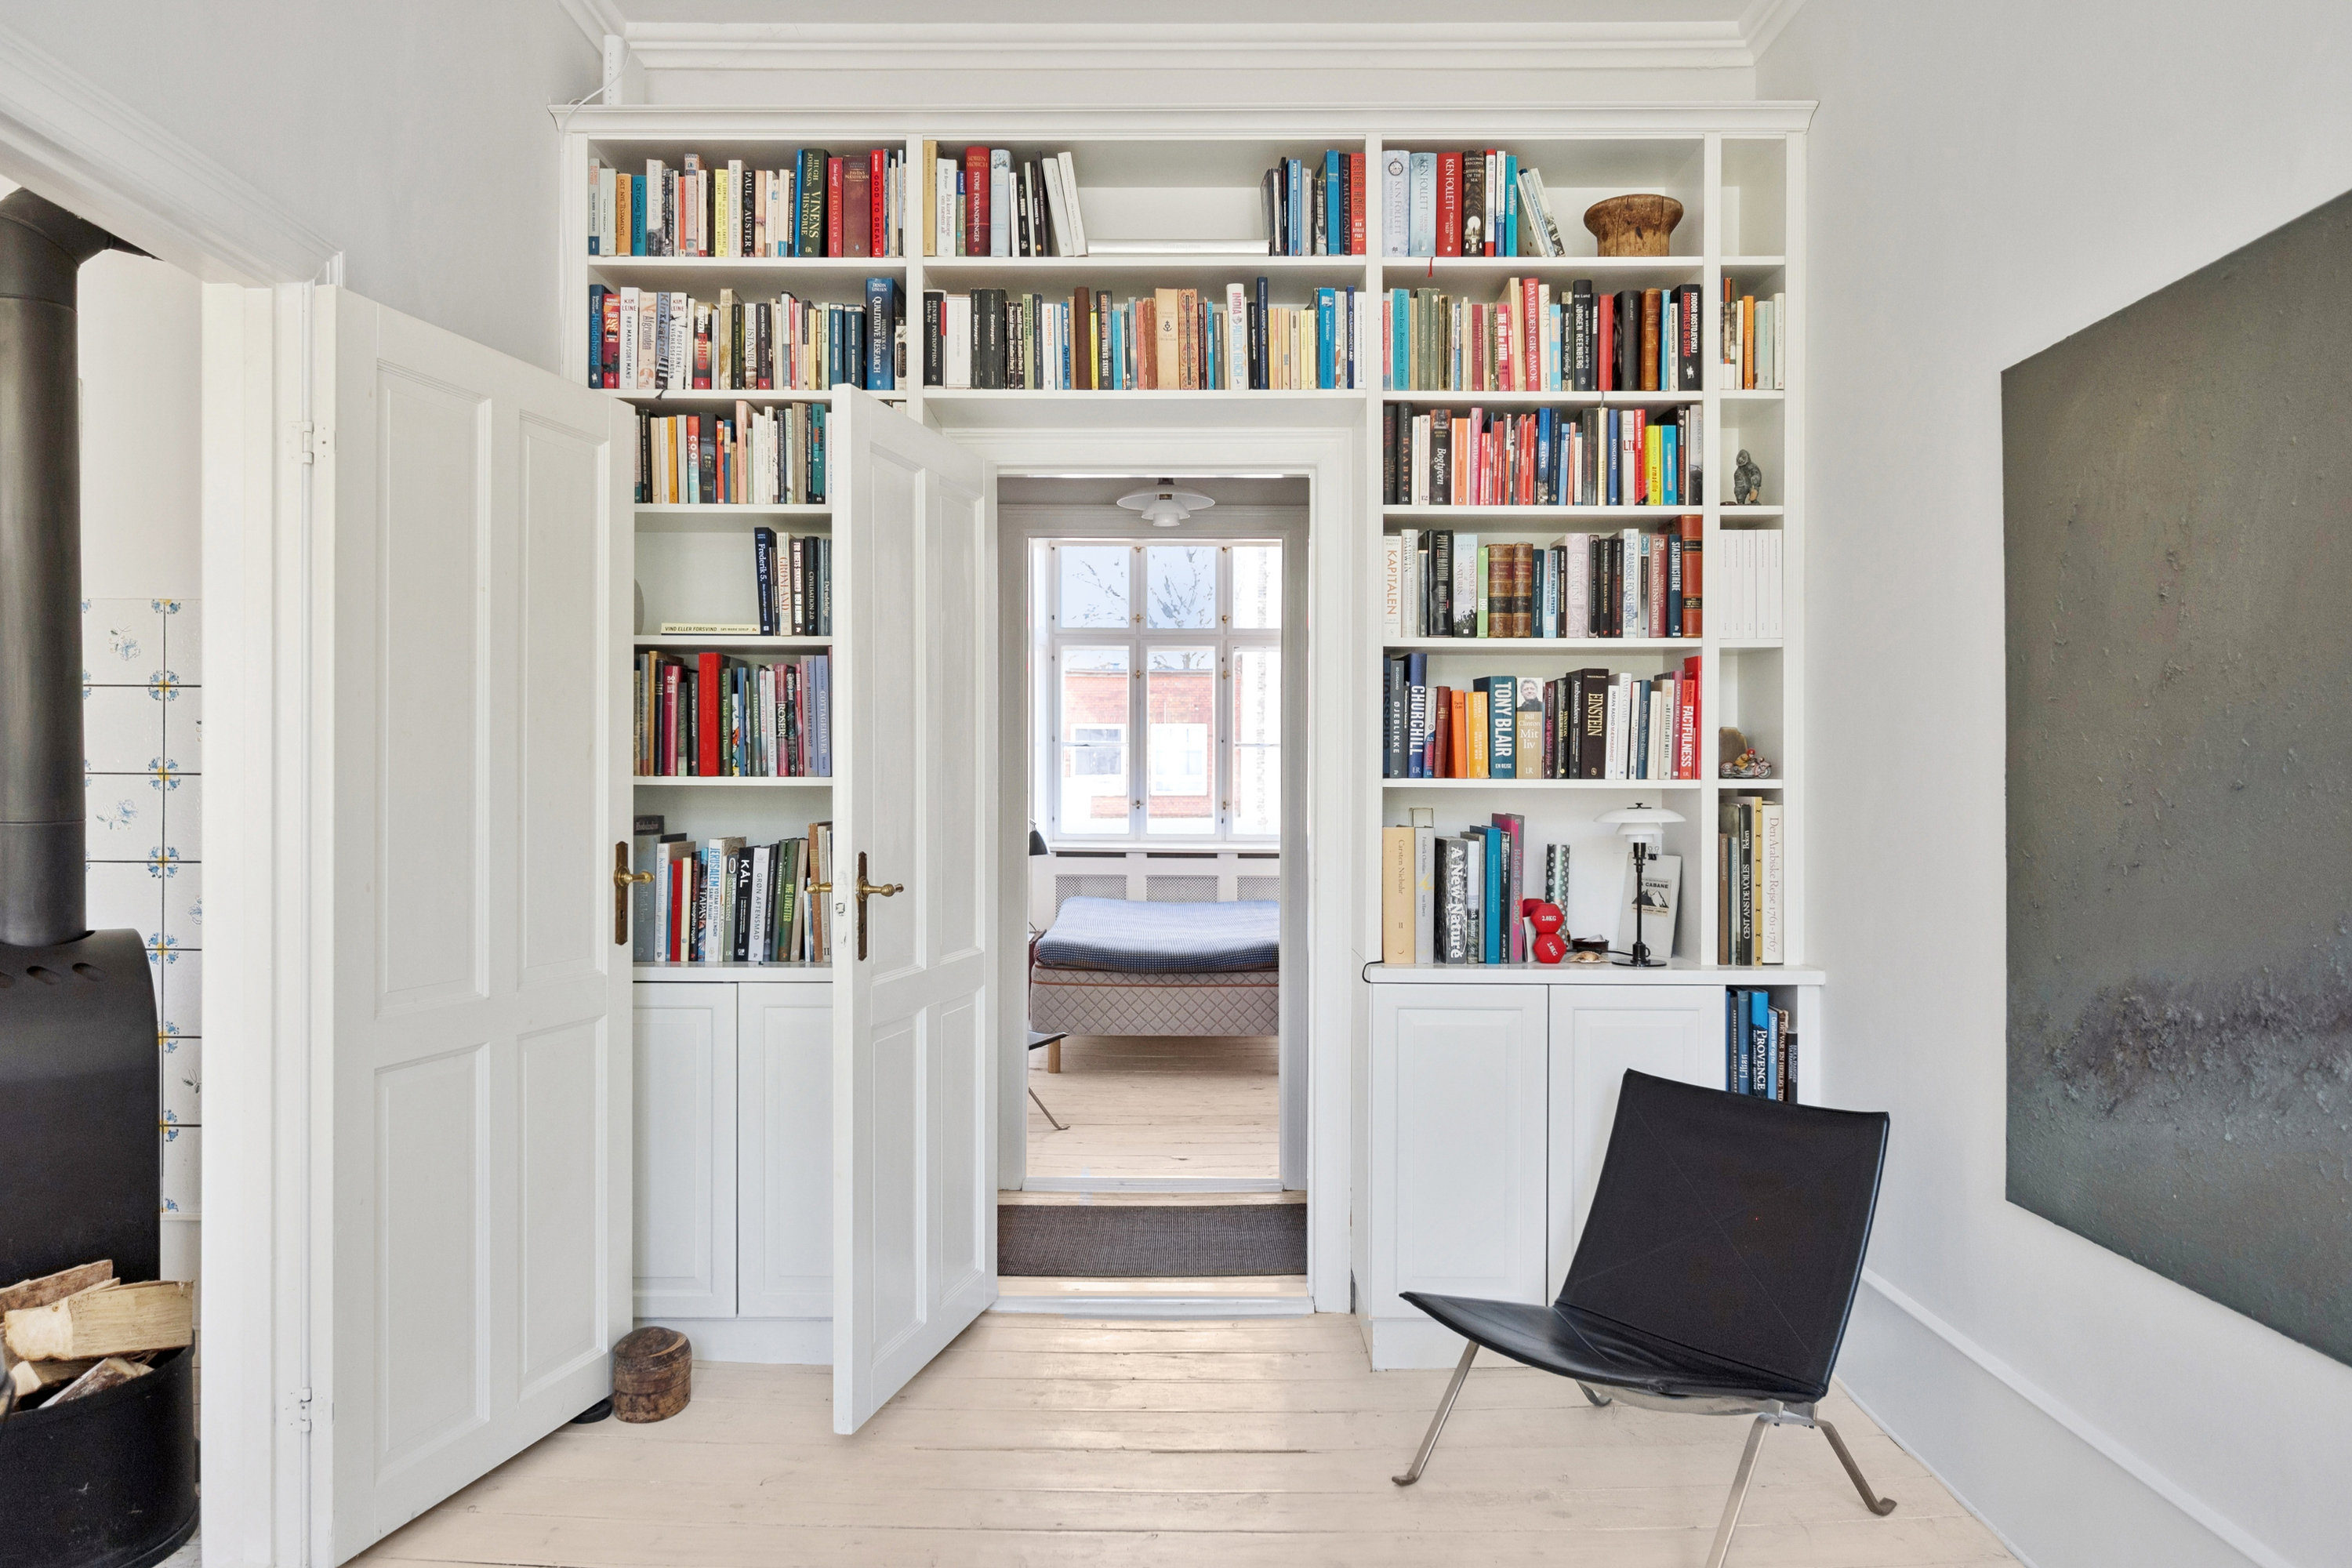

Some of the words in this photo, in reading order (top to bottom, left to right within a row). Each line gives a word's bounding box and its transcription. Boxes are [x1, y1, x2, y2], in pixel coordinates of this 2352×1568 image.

[1343, 169, 1349, 180] DE
[1446, 159, 1454, 176] KEN
[874, 203, 880, 212] TO
[1446, 178, 1454, 211] FOLLETT
[801, 193, 810, 235] HISTORIE
[809, 191, 821, 238] VINENS
[1528, 283, 1535, 295] DA
[873, 296, 882, 336] QUALITATIVE
[1232, 293, 1241, 315] INDIA
[1498, 314, 1507, 323] THE
[1498, 325, 1507, 336] END
[591, 314, 600, 366] Hundehoved
[642, 316, 655, 350] Afgrunden
[697, 333, 708, 369] FRIHED
[1498, 344, 1508, 361] FAITH
[690, 474, 698, 484] IT
[1434, 448, 1446, 485] Bogtyven
[1437, 535, 1448, 549] PITY
[1436, 559, 1448, 581] NATION
[1626, 553, 1635, 581] ARABISKE
[1671, 542, 1680, 591] STATSMINISTRENE
[779, 557, 790, 610] GRØNLAND
[1387, 550, 1397, 615] KAPITALEN
[1626, 583, 1635, 601] FOLKS
[1495, 682, 1512, 715] TONY
[777, 703, 786, 736] ROSER
[1410, 685, 1425, 755] CHURCHILL
[1587, 693, 1603, 736] EINSTEIN
[1495, 719, 1512, 757] BLAIR
[1520, 729, 1538, 739] Mit
[1523, 739, 1536, 749] liv
[1682, 706, 1694, 767] FACTFULNESS
[1769, 818, 1779, 837] Den
[1450, 847, 1463, 859] A
[1769, 839, 1780, 879] Arabiske
[709, 848, 720, 887] JERUSALEM
[740, 859, 750, 887] KÅL
[1450, 865, 1463, 895] New
[785, 884, 794, 894] NYE
[1744, 891, 1750, 901] DE
[1766, 880, 1778, 903] Rejse
[699, 891, 707, 919] TAPAS
[783, 895, 793, 922] LIVRETTER
[1449, 903, 1465, 958] Nature
[1766, 906, 1778, 953] 1761-1767
[1547, 942, 1559, 956] 2.0KG
[1757, 1029, 1767, 1091] PROVENCE
[1778, 1051, 1784, 1061] EN
